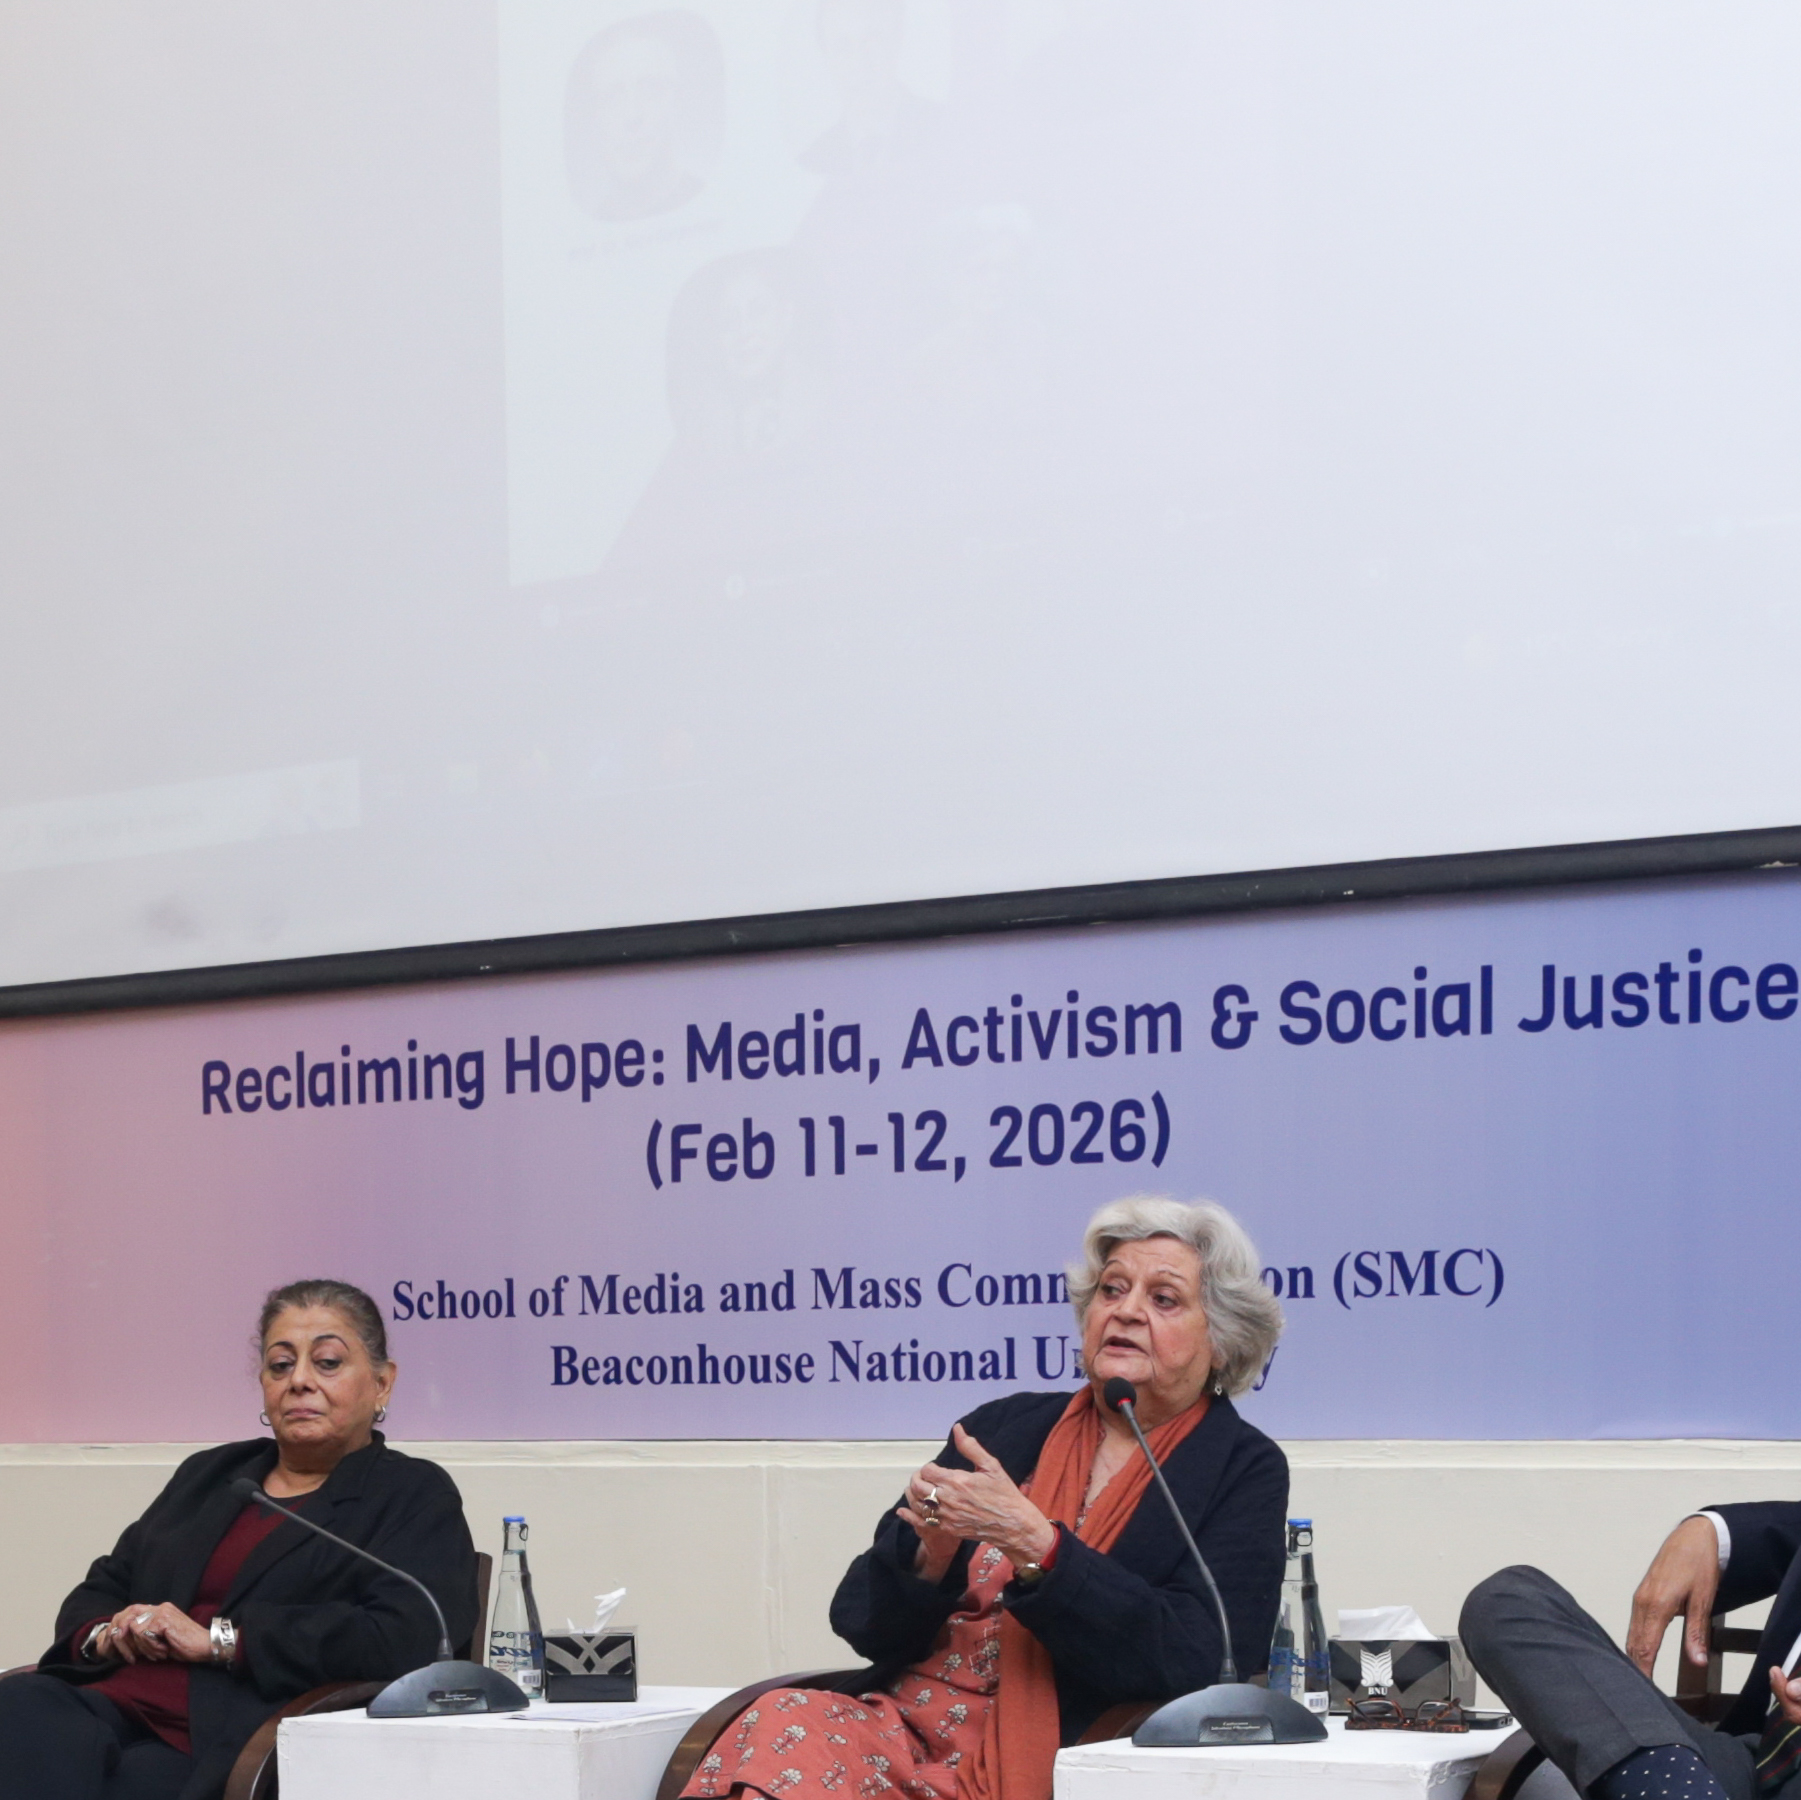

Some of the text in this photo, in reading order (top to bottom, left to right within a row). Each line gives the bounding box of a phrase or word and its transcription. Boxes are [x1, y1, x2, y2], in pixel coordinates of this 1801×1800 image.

[203, 949, 1798, 1114] Reclaiming Hope: Media, Activism & Social Justice
[647, 1091, 1170, 1190] (Feb 11-12, 2026)
[394, 1278, 515, 1320] School
[529, 1276, 569, 1317] of
[579, 1273, 704, 1315] Media
[720, 1270, 795, 1312] and
[812, 1268, 921, 1309] Mass
[1334, 1249, 1503, 1309] (SMC)
[551, 1344, 814, 1385] Beaconhouse
[829, 1338, 1016, 1381] National
[1368, 1686, 1388, 1696] BNU
